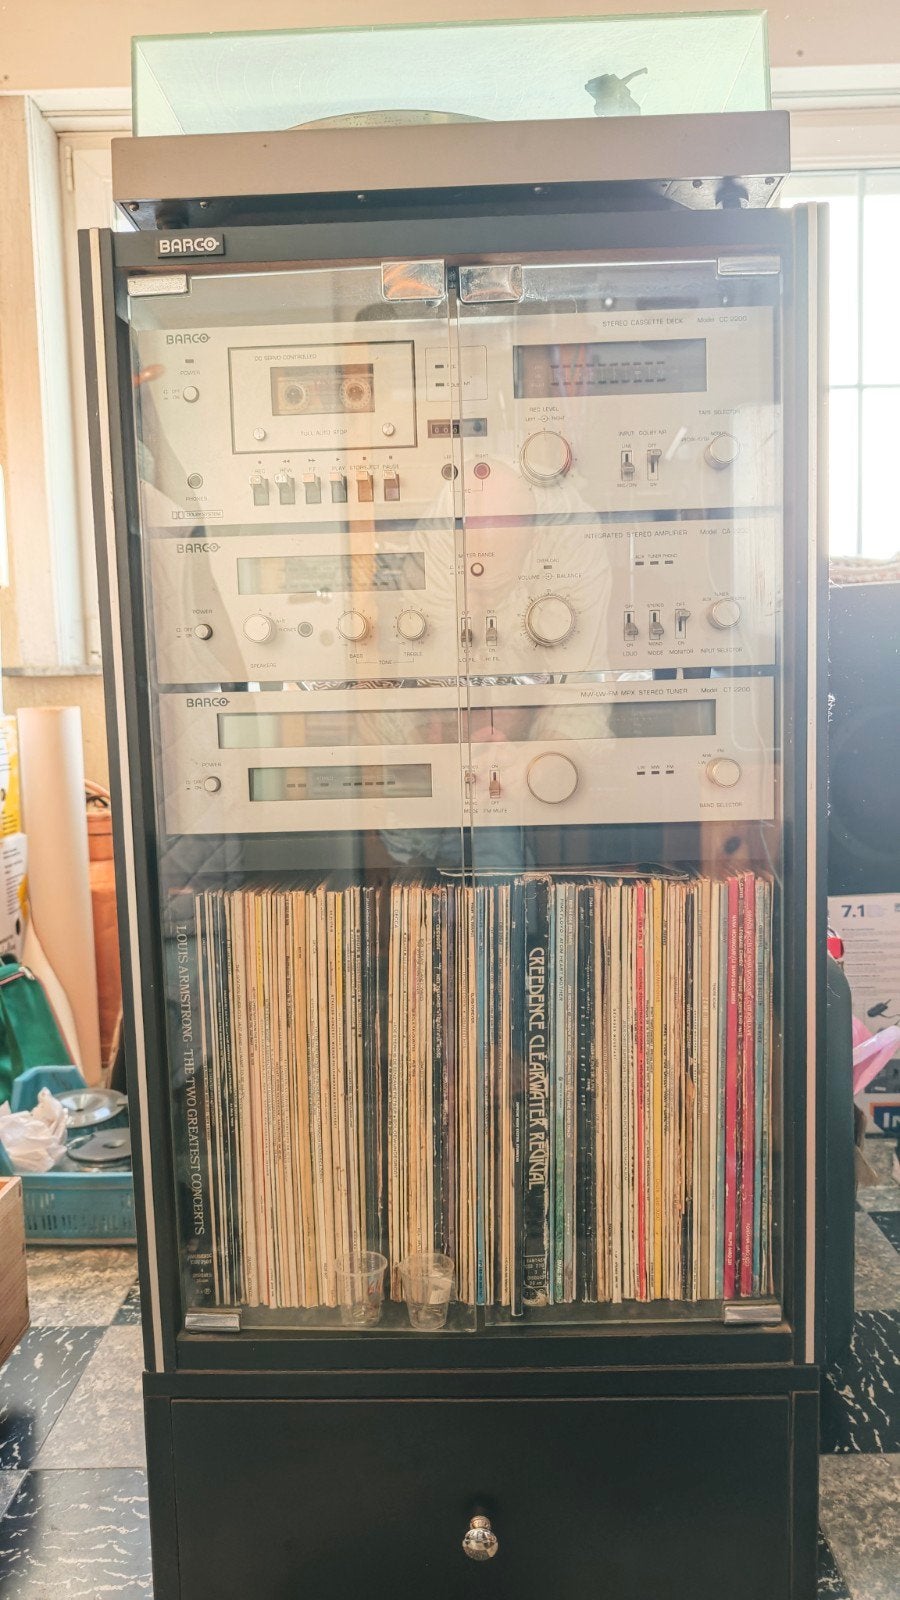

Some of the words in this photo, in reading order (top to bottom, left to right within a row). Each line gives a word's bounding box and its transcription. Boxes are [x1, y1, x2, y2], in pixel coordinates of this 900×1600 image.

[159, 237, 220, 254] BARCO
[602, 320, 628, 328] STEREO
[631, 318, 664, 327] CASSETTE
[666, 317, 684, 326] DECK
[166, 333, 211, 345] BARCO
[176, 542, 221, 554] BARCO
[584, 532, 624, 540] INTEGRATED
[186, 697, 231, 708] BARCO
[841, 905, 865, 918] 7.1
[176, 925, 190, 964] LOUIS
[528, 947, 547, 1032] CREEDENCE
[178, 965, 194, 1043] ARMSTRONG
[183, 1049, 195, 1075] THE
[185, 1077, 198, 1106] TWO
[528, 1035, 548, 1127] CLEARWATER
[186, 1108, 201, 1172] GREATEST
[528, 1132, 547, 1190] REVIVAL
[190, 1173, 206, 1236] CONCERTS
